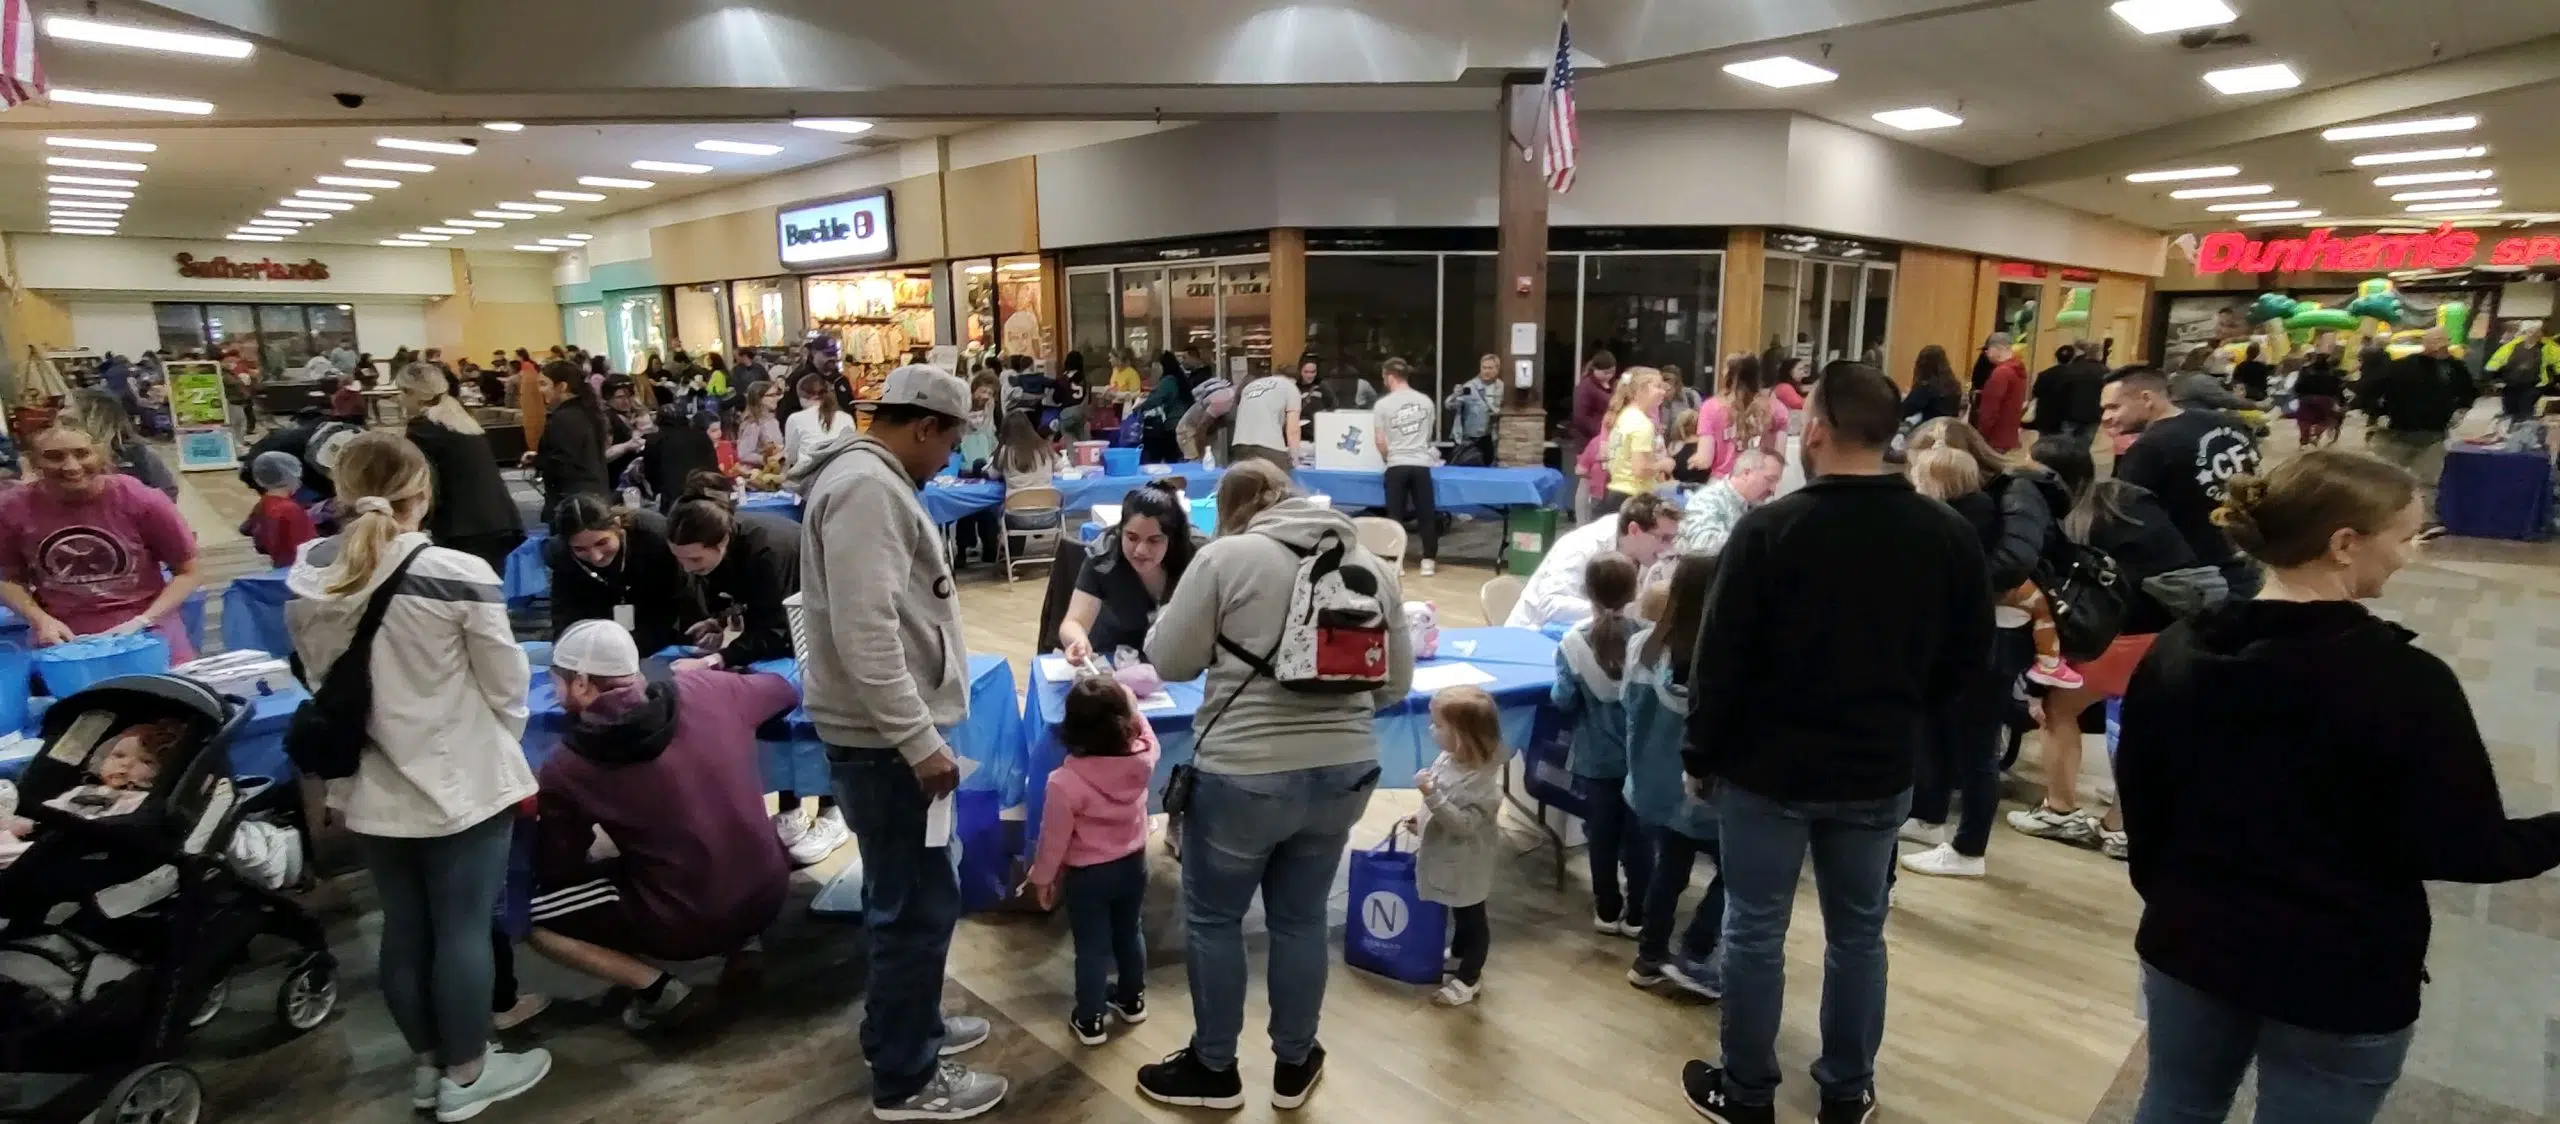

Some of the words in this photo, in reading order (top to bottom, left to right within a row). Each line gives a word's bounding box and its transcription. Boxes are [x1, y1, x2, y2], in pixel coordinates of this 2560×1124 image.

[785, 216, 851, 247] Buckle
[2197, 221, 2481, 274] Dunham's
[2490, 235, 2560, 266] SP
[175, 251, 330, 281] Sutherlands
[1071, 382, 1084, 399] 5
[1371, 898, 1397, 933] N
